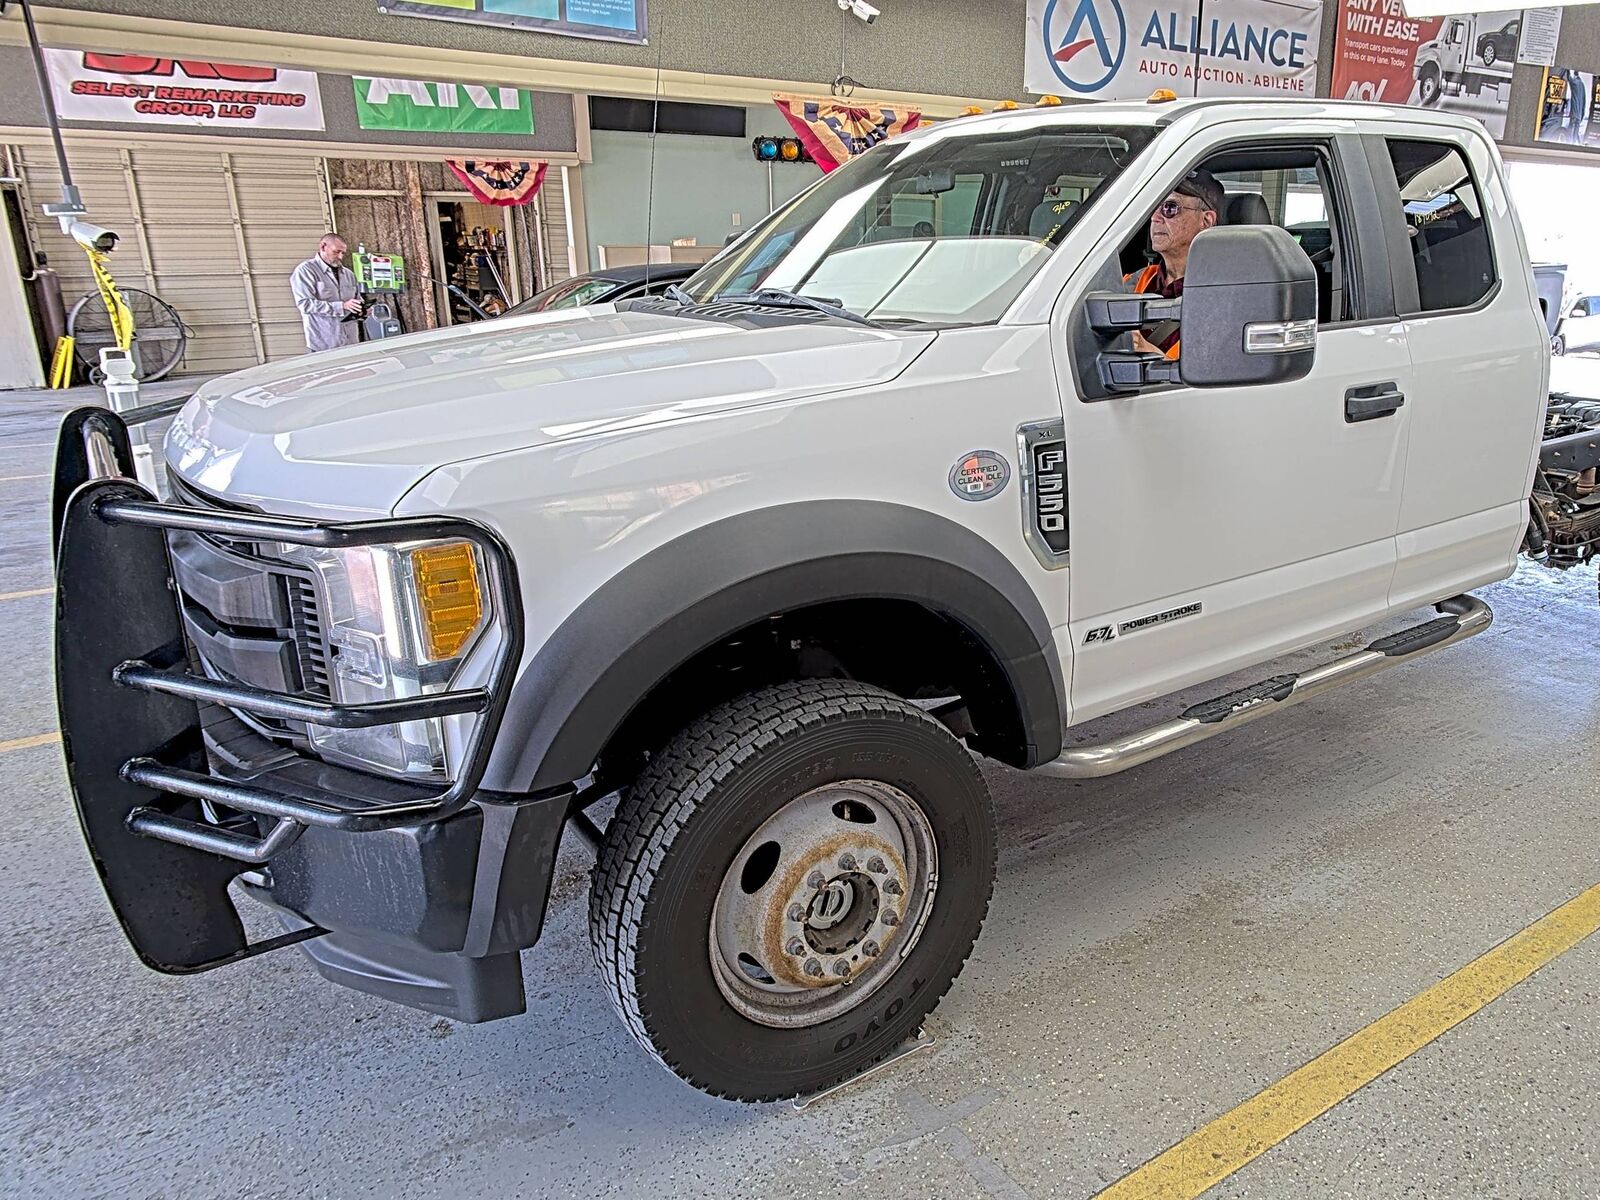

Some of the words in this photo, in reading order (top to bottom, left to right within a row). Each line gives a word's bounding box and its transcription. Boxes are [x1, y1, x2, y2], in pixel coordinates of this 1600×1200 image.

[1347, 11, 1383, 36] WITH
[1384, 18, 1420, 42] EASE.
[1140, 9, 1308, 69] ALLIANCE
[1344, 37, 1369, 50] Transport
[1369, 44, 1381, 52] cars
[1381, 46, 1409, 56] purchased
[1349, 51, 1360, 60] this
[1367, 55, 1377, 65] any
[1139, 59, 1178, 77] AUTO
[1184, 65, 1244, 85] AUCTION
[1253, 74, 1304, 92] ABILENE
[70, 80, 152, 99] SELECT
[155, 87, 306, 107] REMARKETING
[135, 100, 215, 118] GROUP,
[218, 104, 256, 118] LLC
[1038, 430, 1054, 439] XL
[957, 475, 983, 485] CLEAN
[986, 472, 1003, 481] IDLE
[960, 464, 998, 476] CERTIFIED
[1121, 614, 1160, 631] POWER
[1160, 602, 1201, 620] STROKE
[834, 978, 927, 1054] TOYO
